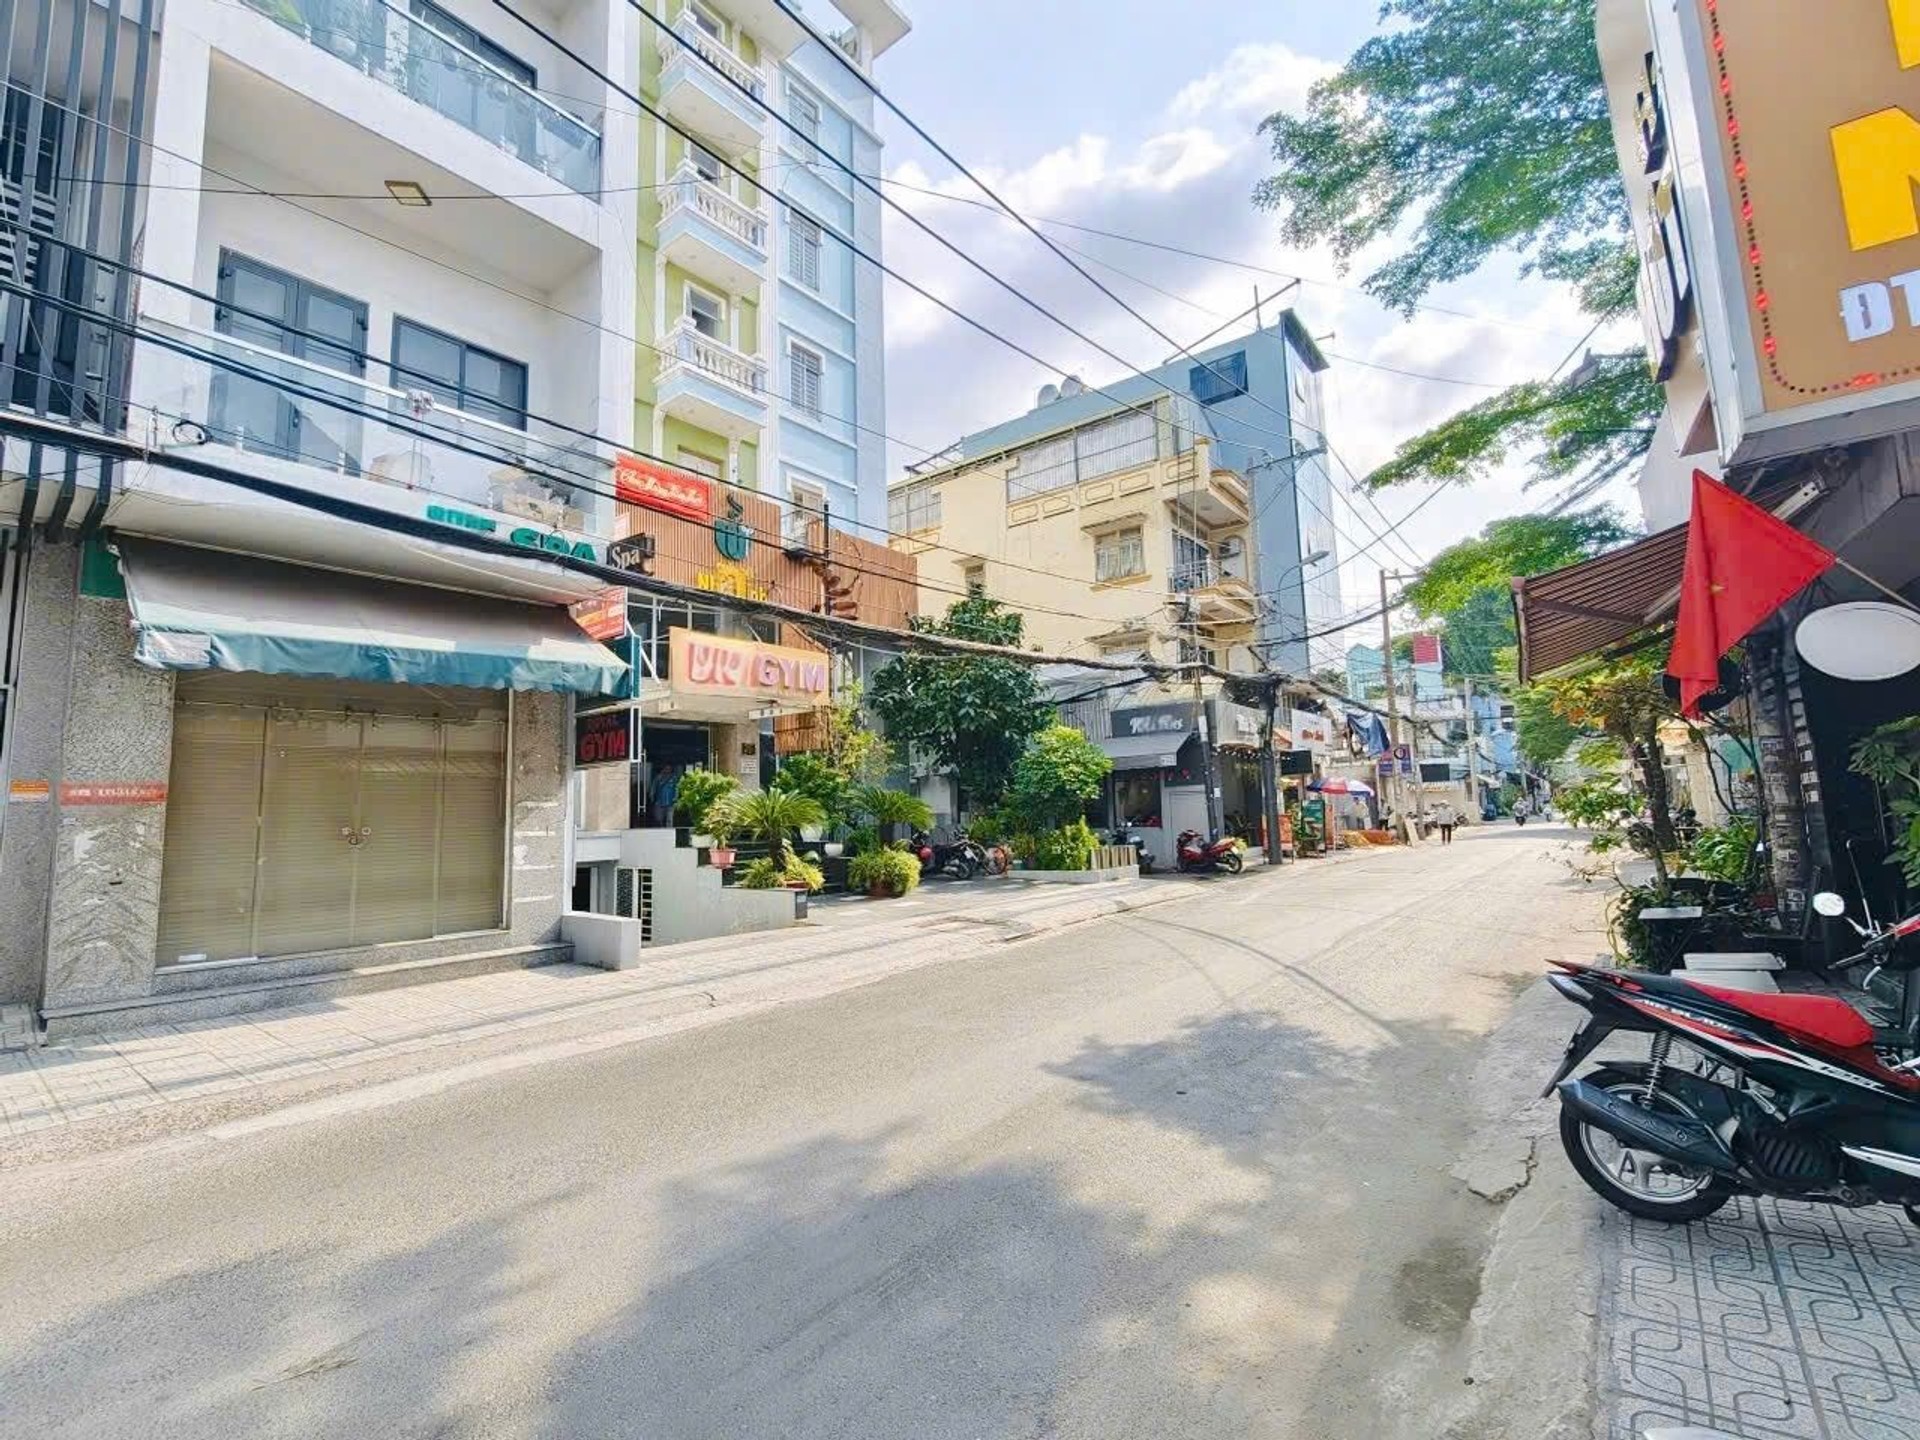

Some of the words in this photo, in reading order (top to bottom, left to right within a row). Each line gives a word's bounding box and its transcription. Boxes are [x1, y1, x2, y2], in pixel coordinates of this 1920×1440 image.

[611, 546, 640, 570] Spa
[757, 653, 825, 693] GYM
[580, 729, 626, 762] GYM
